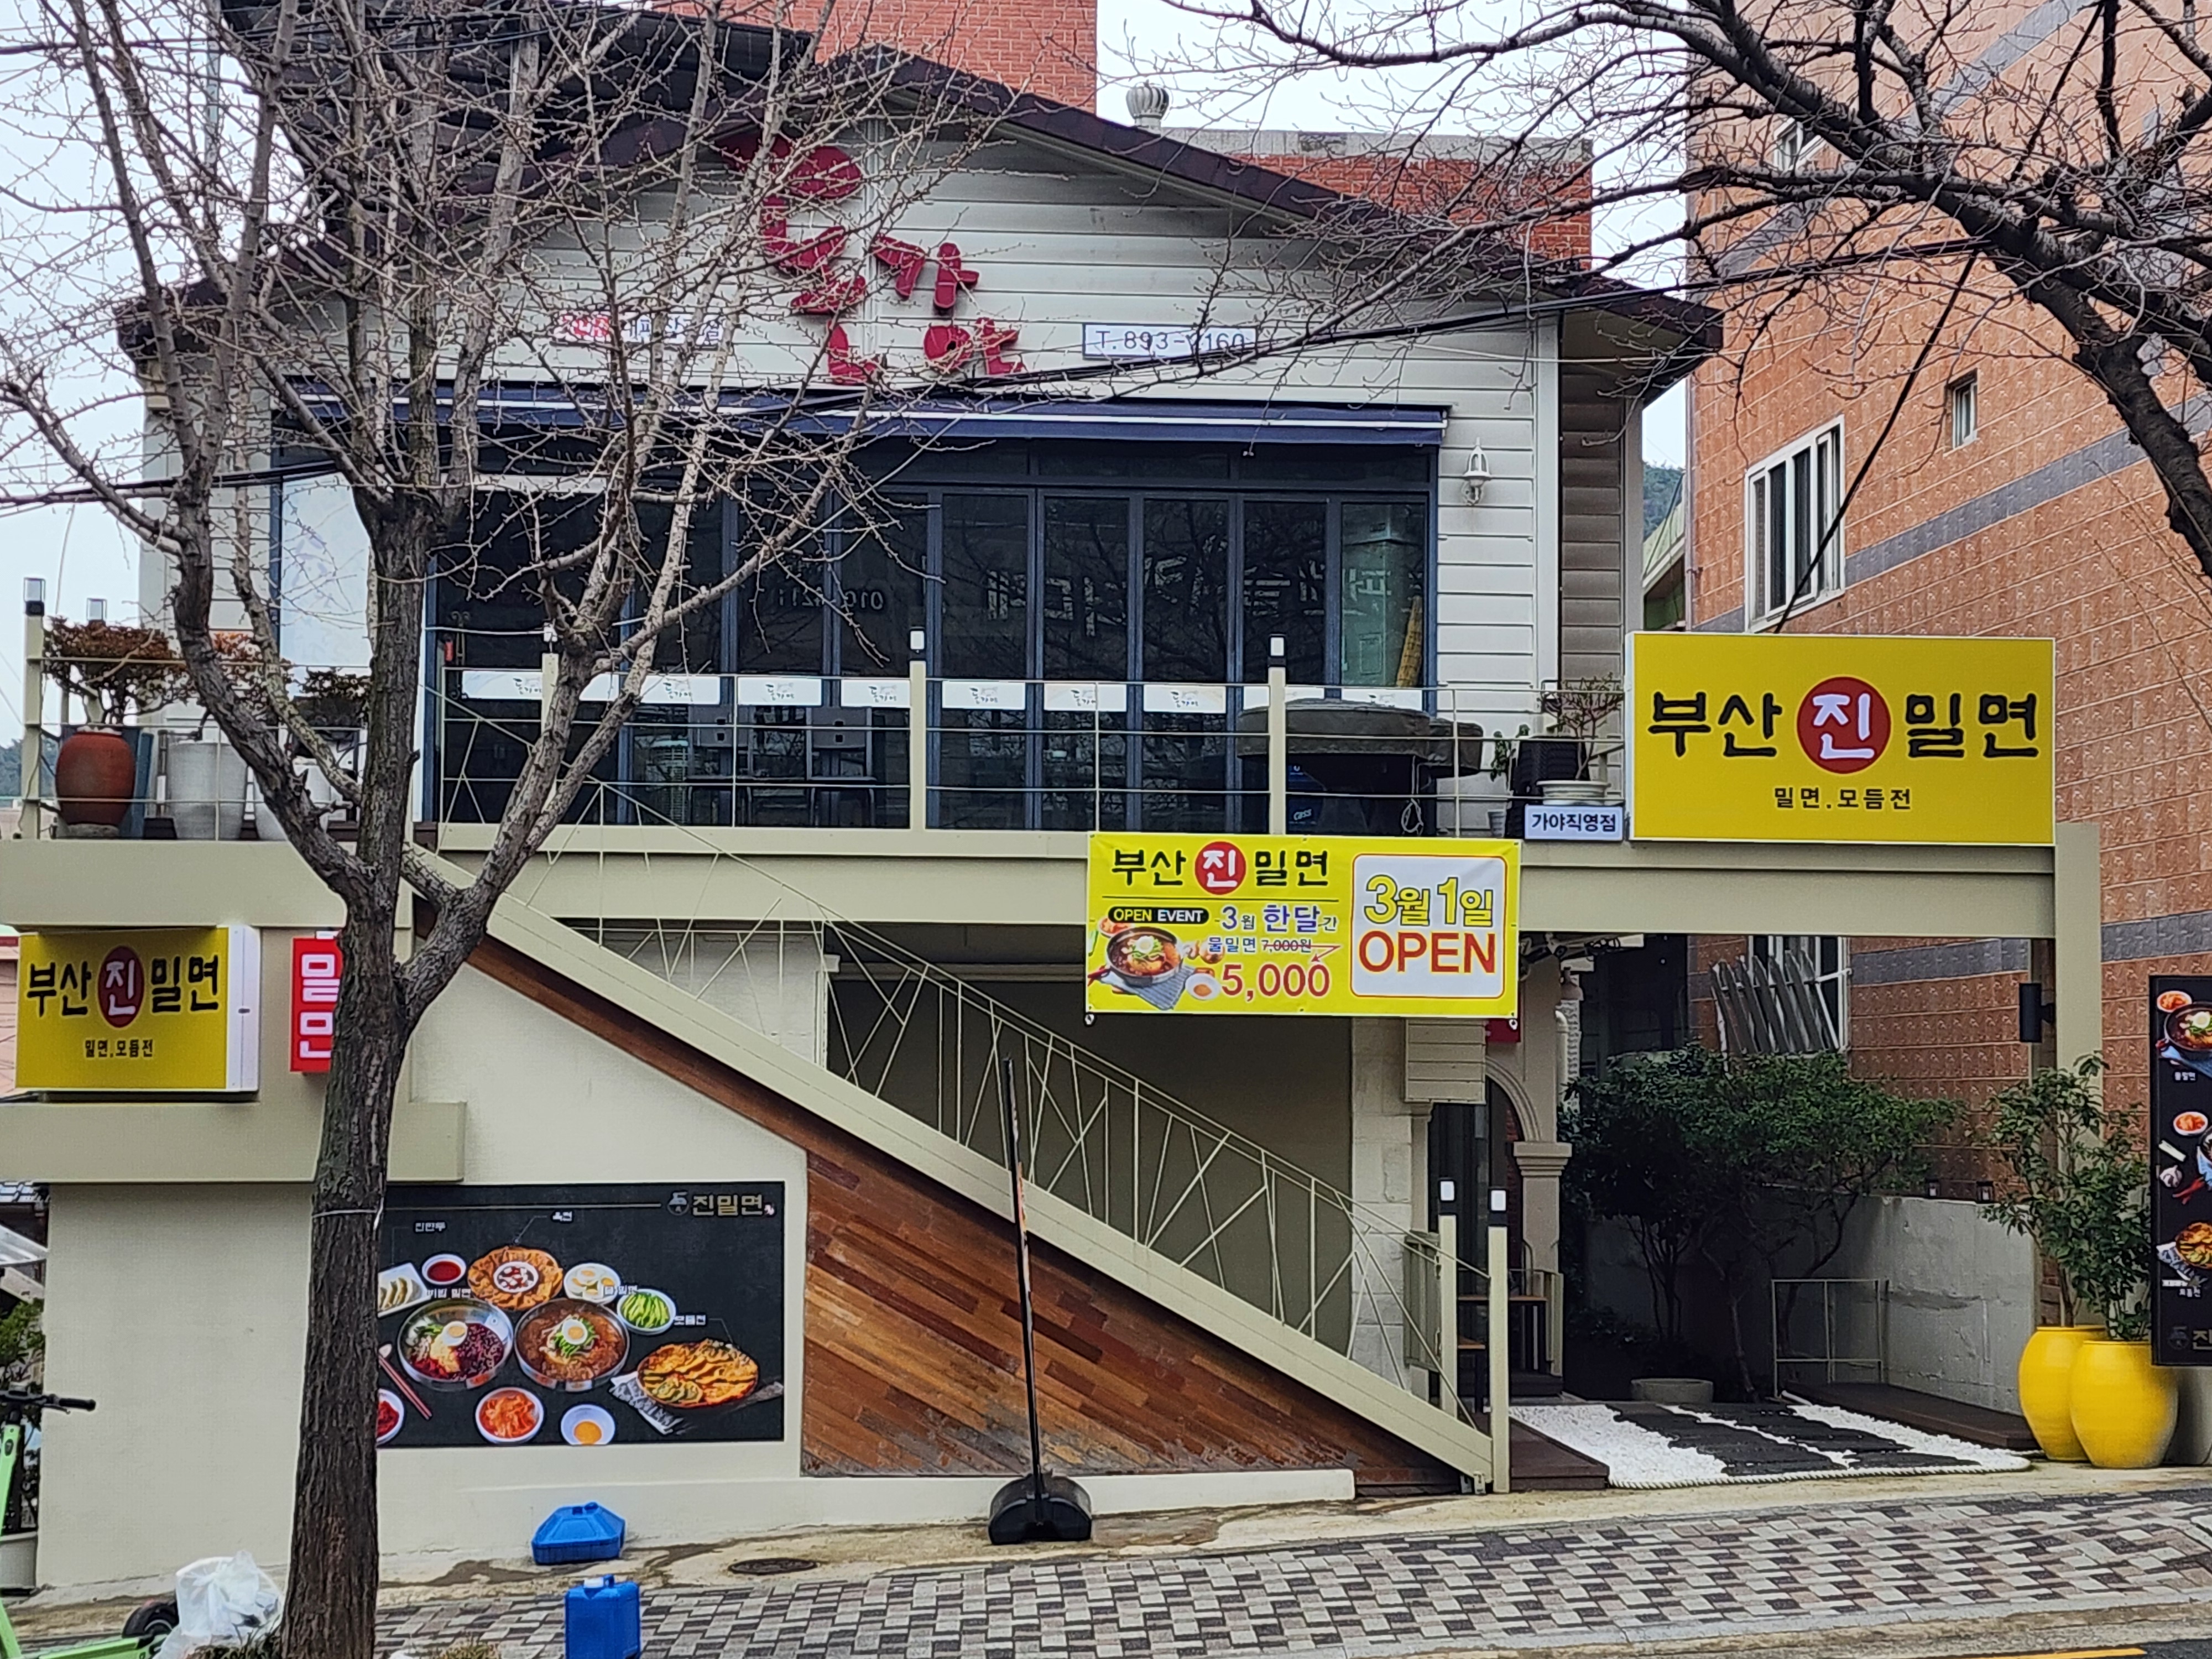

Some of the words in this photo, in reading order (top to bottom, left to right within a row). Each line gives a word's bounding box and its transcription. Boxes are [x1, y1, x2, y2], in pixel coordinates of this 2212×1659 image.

[1531, 812, 1616, 832] 가야직영점
[1364, 874, 1430, 926] 3월
[1437, 877, 1494, 927] 1일
[1113, 908, 1152, 922] OPEN
[1157, 909, 1204, 923] EVENT
[1222, 906, 1255, 930] 3월
[1208, 937, 1256, 953] 물밀면
[1261, 938, 1311, 953] 7,000원
[1359, 930, 1496, 974] OPEN
[1222, 963, 1330, 1002] 5,000
[692, 1194, 763, 1216] 진밀면
